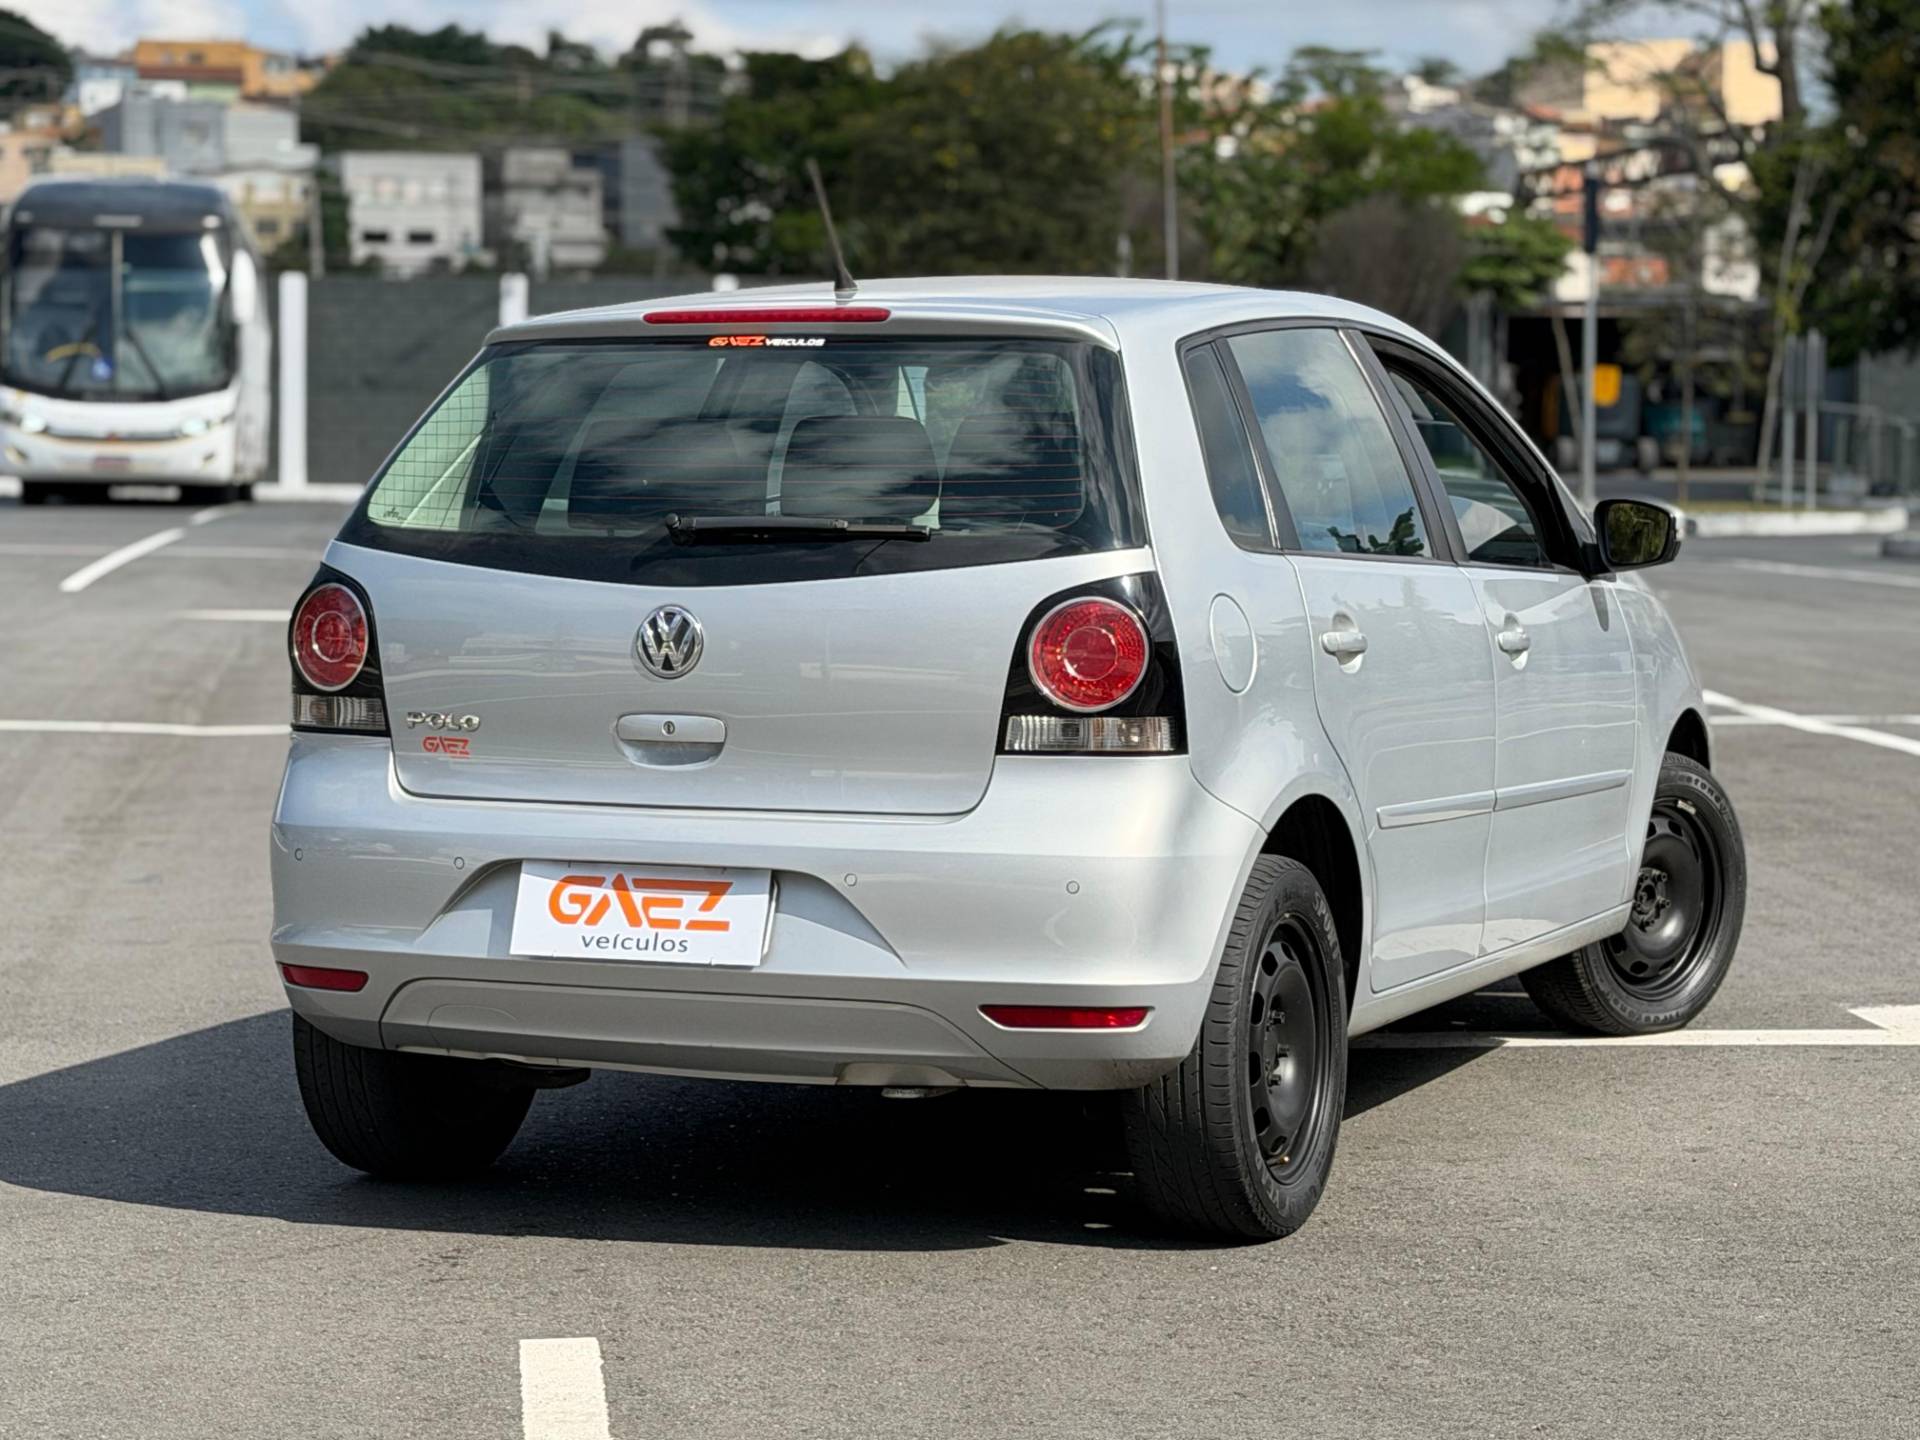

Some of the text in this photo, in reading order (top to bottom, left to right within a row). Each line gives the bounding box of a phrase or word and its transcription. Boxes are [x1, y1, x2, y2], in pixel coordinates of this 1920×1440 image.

[406, 711, 481, 732] POLO
[422, 736, 470, 756] GAEZ
[548, 873, 734, 932] GAEZ
[581, 932, 689, 953] veículos
